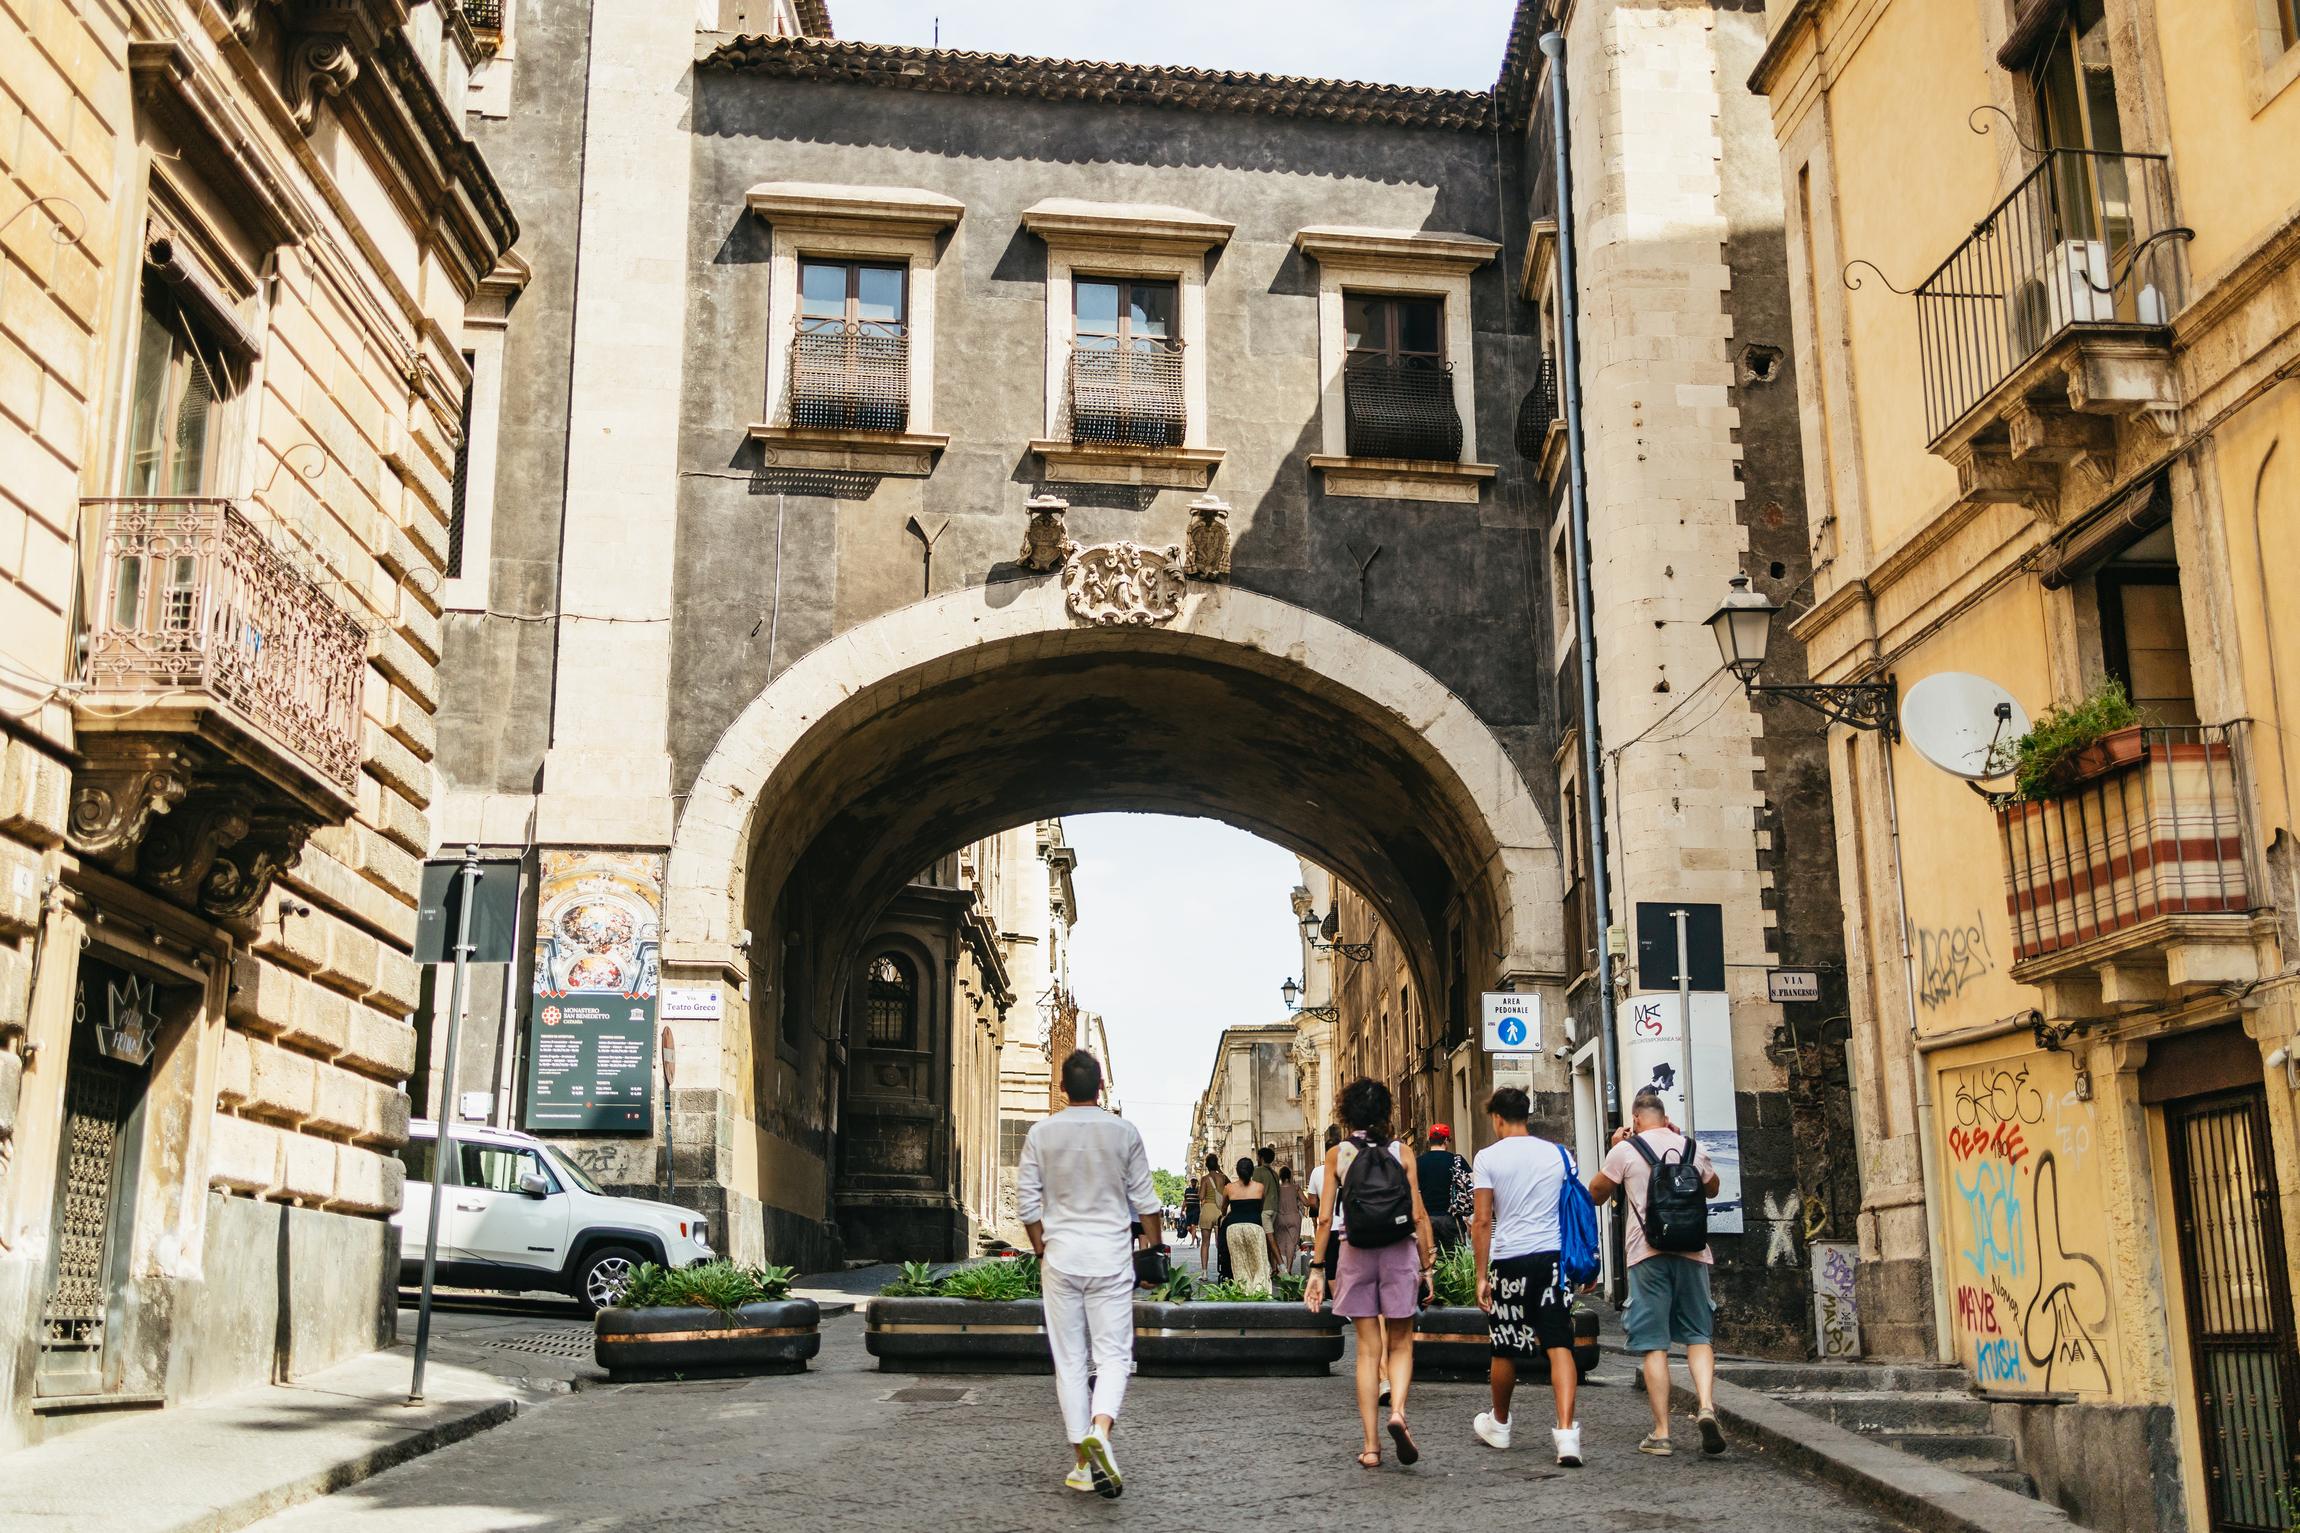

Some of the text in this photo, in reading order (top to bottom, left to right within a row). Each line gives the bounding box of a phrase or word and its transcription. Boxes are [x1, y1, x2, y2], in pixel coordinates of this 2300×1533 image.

[1783, 976, 1803, 985] VIA
[667, 1003, 717, 1011] Teatro Greco
[1495, 1006, 1529, 1014] PEDONALE
[1500, 1276, 1527, 1299] BOY
